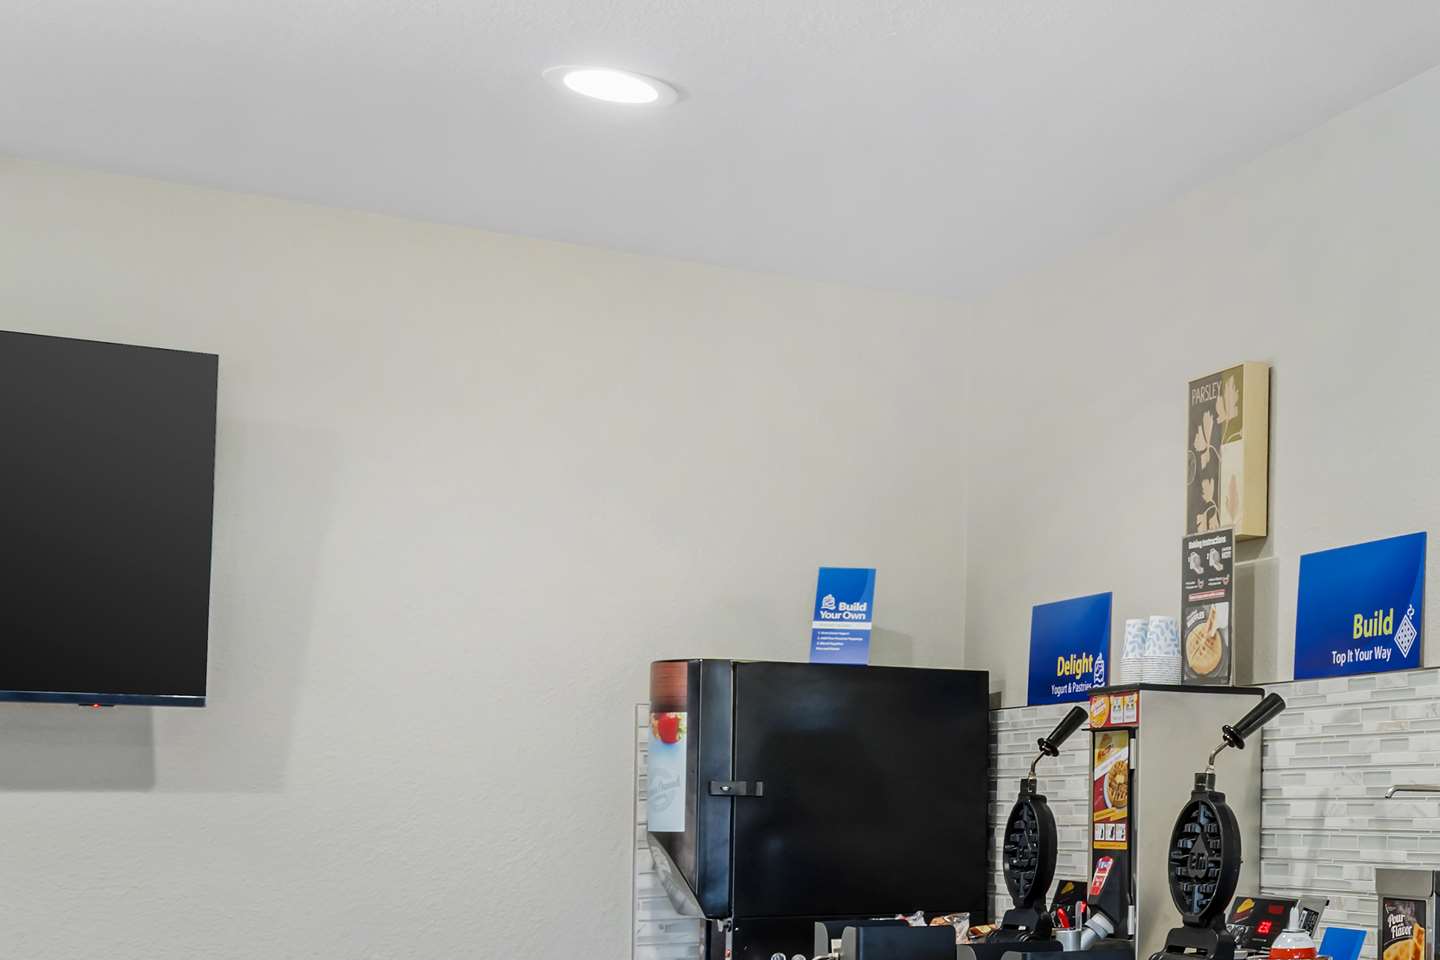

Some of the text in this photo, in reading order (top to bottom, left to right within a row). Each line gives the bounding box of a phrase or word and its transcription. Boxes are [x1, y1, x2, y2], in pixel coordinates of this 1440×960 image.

[1191, 381, 1222, 407] PARSLEY
[839, 602, 867, 611] Build
[820, 610, 866, 620] Your Own
[1353, 608, 1394, 640] Build
[1331, 645, 1392, 667] Top It Your Way
[1057, 652, 1094, 680] Delight
[1051, 684, 1067, 697] Yogurt
[1387, 913, 1406, 928] Pour
[1391, 924, 1412, 939] Flavor
